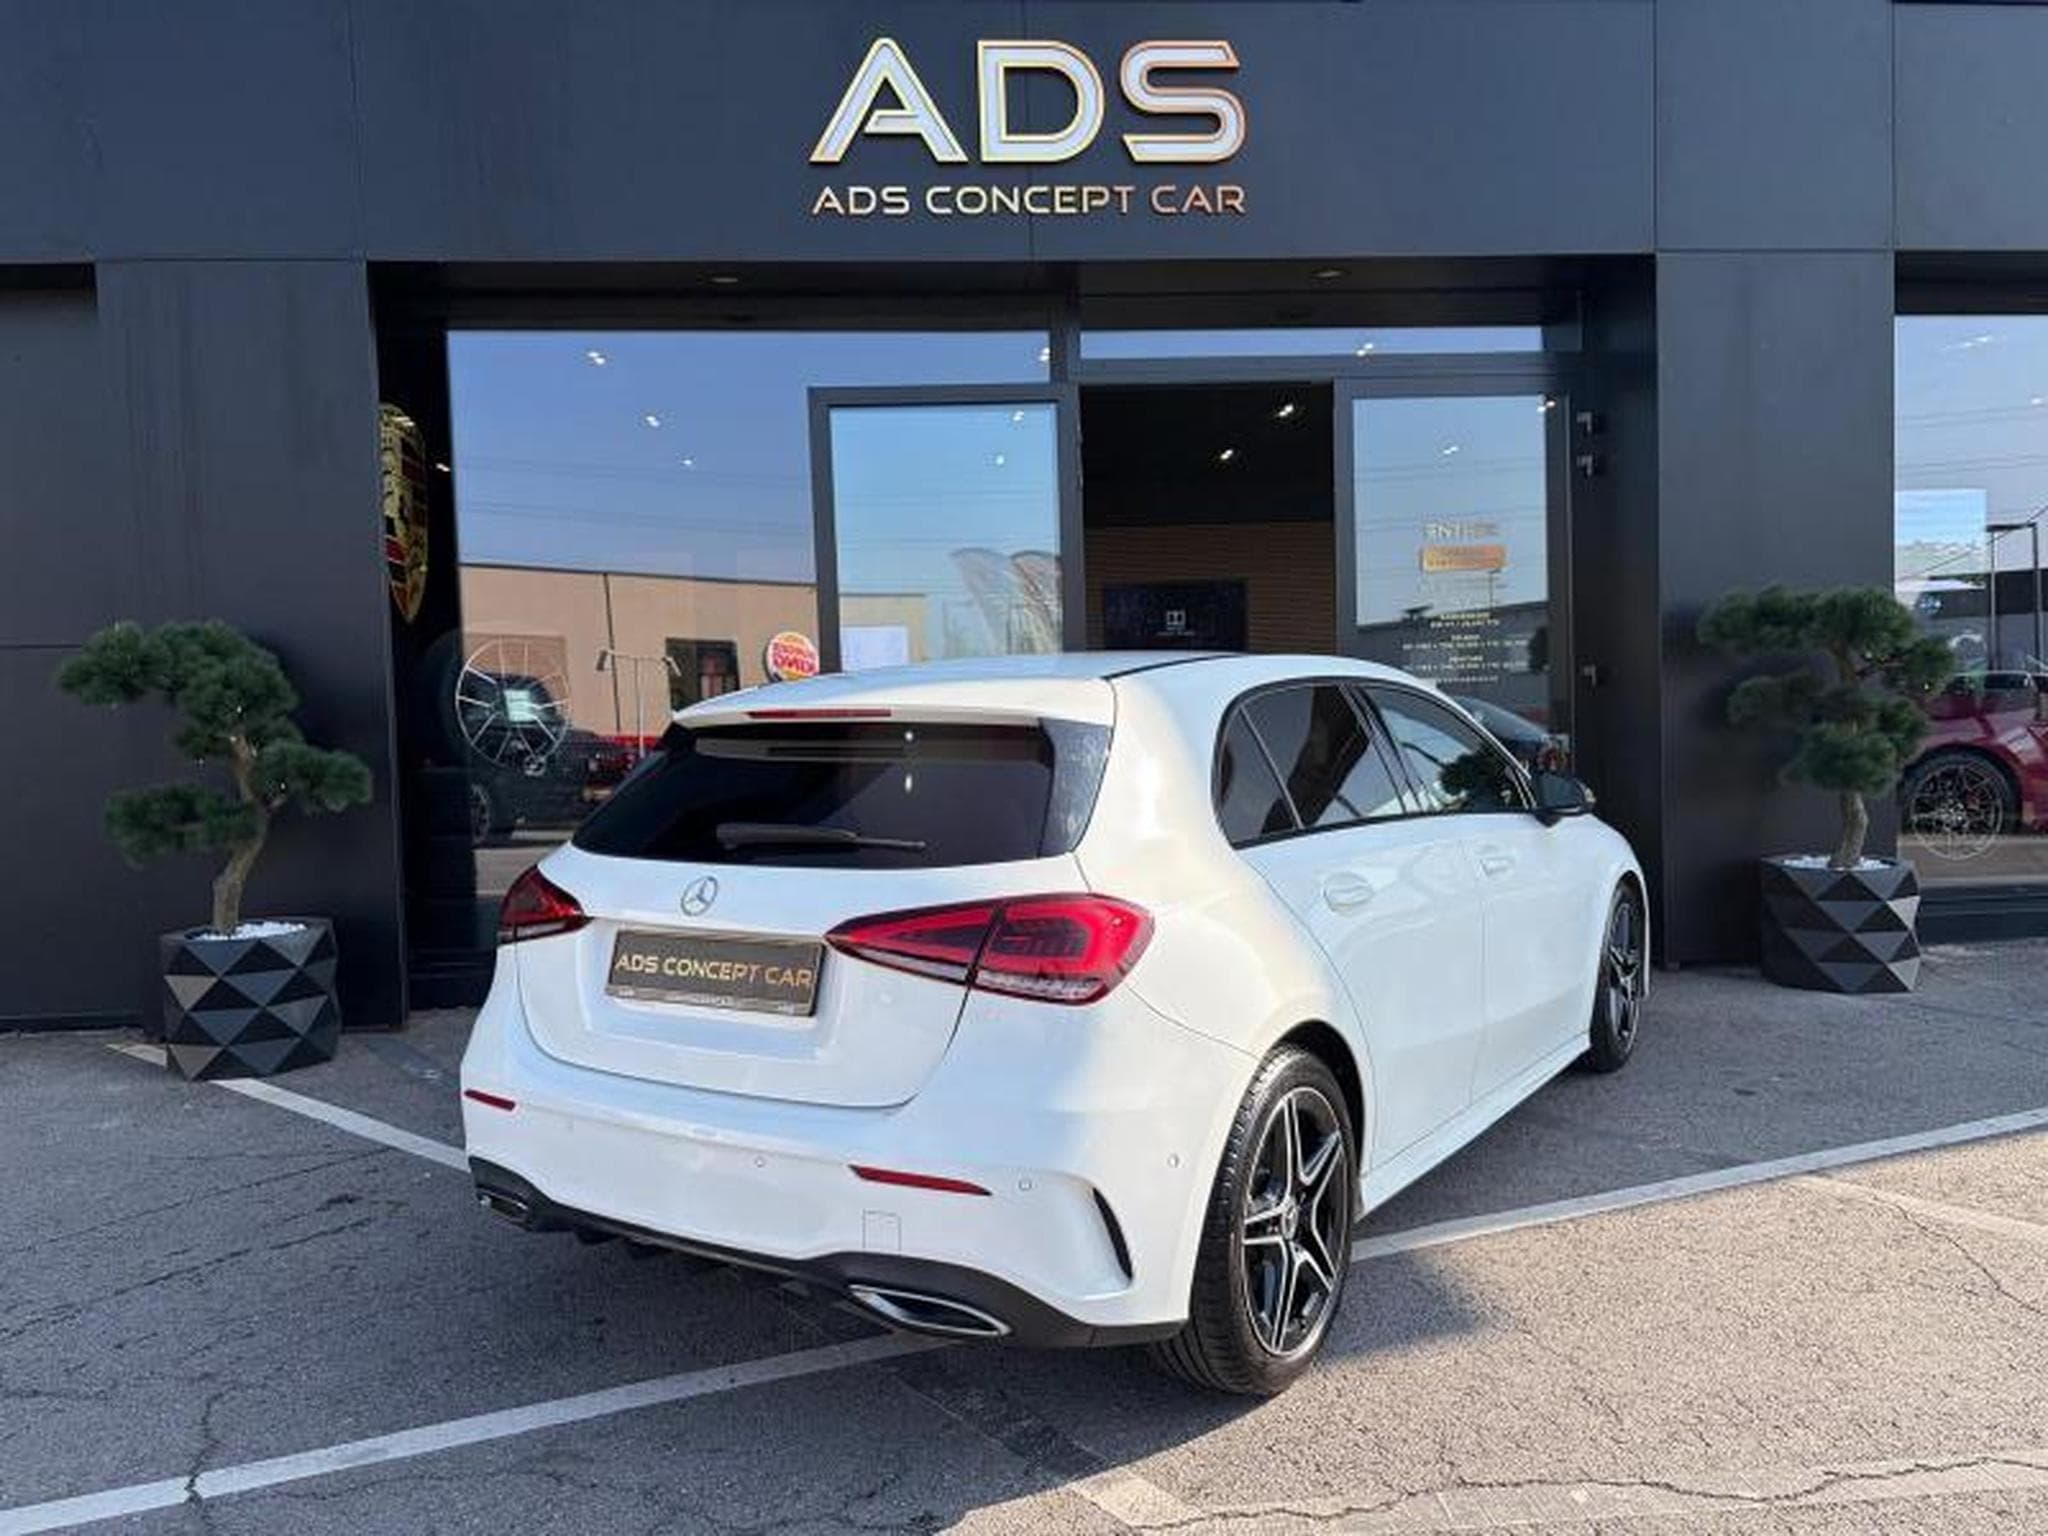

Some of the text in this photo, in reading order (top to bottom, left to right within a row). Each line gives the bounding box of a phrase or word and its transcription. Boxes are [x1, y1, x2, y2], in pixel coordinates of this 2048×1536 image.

[809, 37, 1247, 163] ADS
[812, 185, 1247, 215] ADS CONCEPT CAR
[614, 953, 812, 988] ADS CONCEPT CAR
